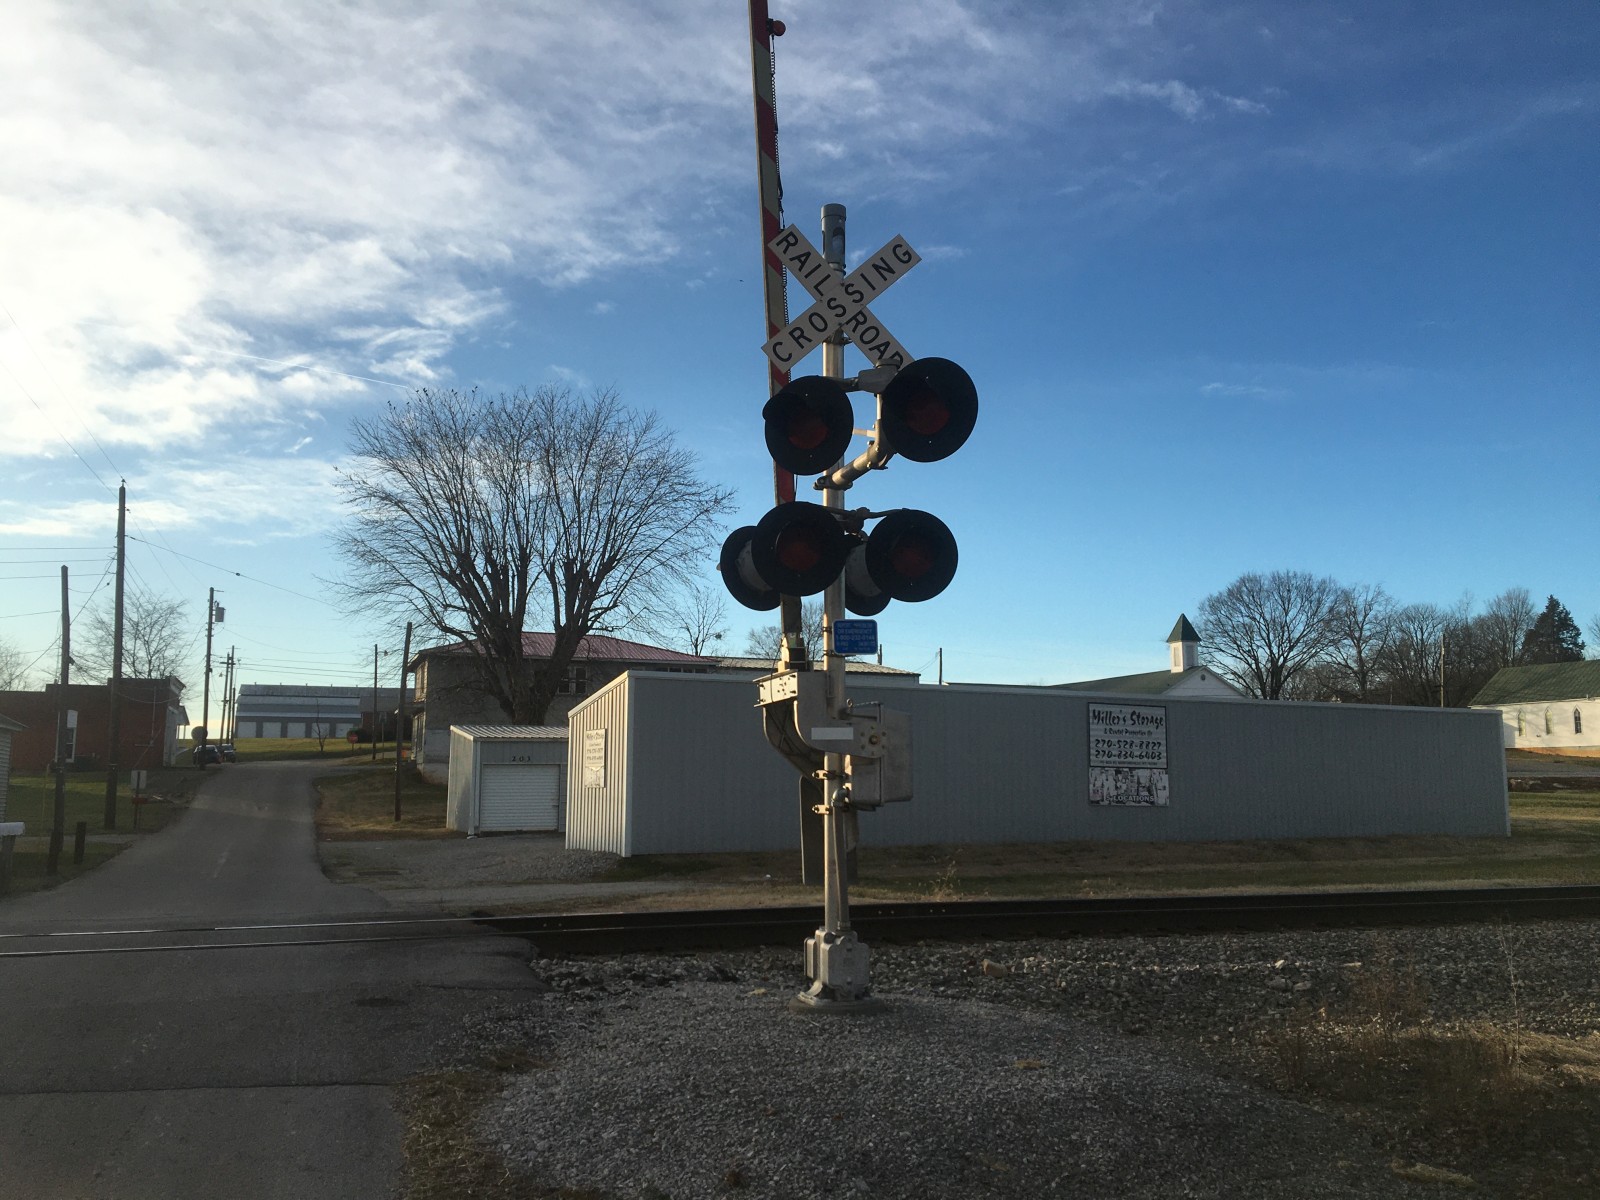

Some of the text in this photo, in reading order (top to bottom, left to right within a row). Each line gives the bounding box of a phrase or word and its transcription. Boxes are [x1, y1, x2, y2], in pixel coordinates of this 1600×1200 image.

[772, 243, 912, 363] CROSSING
[1092, 709, 1164, 730] Miller's Storage
